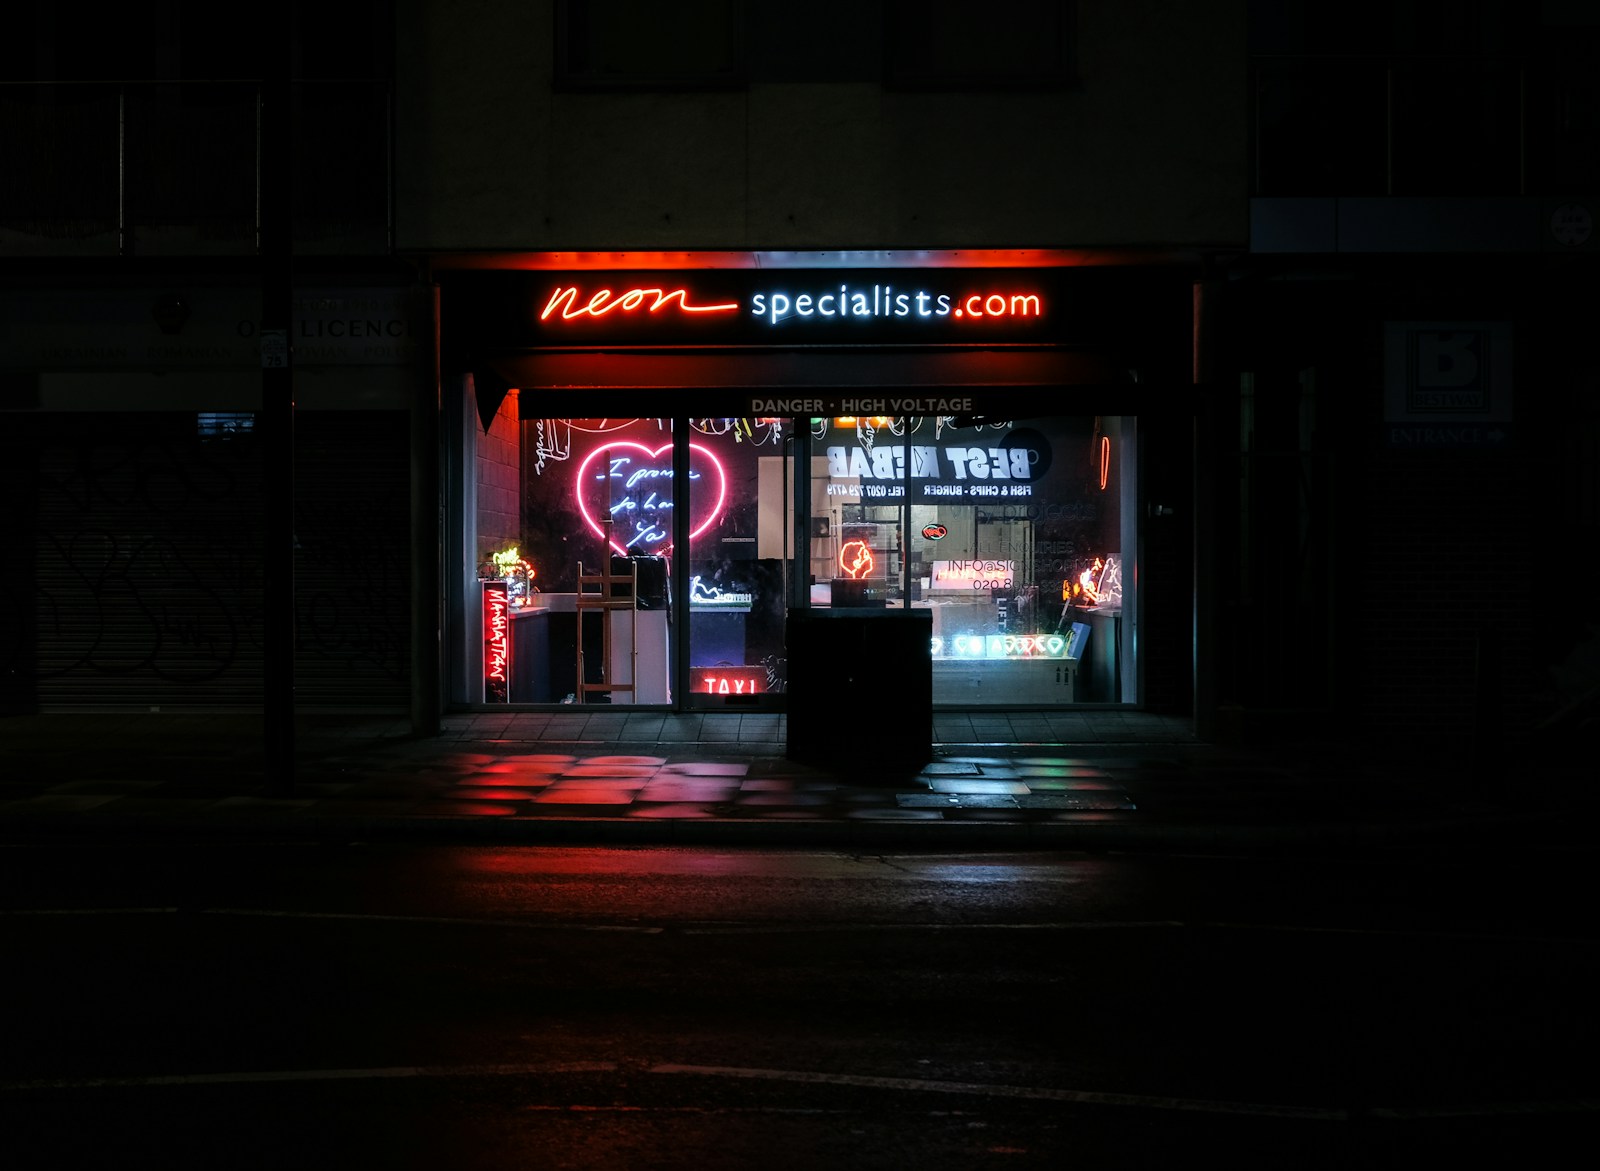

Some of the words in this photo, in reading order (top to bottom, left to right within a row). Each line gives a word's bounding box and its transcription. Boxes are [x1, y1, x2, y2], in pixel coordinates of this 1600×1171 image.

[541, 286, 738, 321] neon
[752, 284, 1042, 324] specialists.com
[267, 356, 282, 366] 75
[751, 399, 825, 412] DANGER
[842, 399, 886, 412] HIGH
[890, 398, 973, 412] VOLTAGE
[1415, 394, 1481, 406] BESTWAY
[1391, 428, 1481, 443] ENTRANCE
[973, 580, 999, 590] 020
[488, 589, 508, 682] MANHATTAN
[705, 679, 756, 694] TAXI
